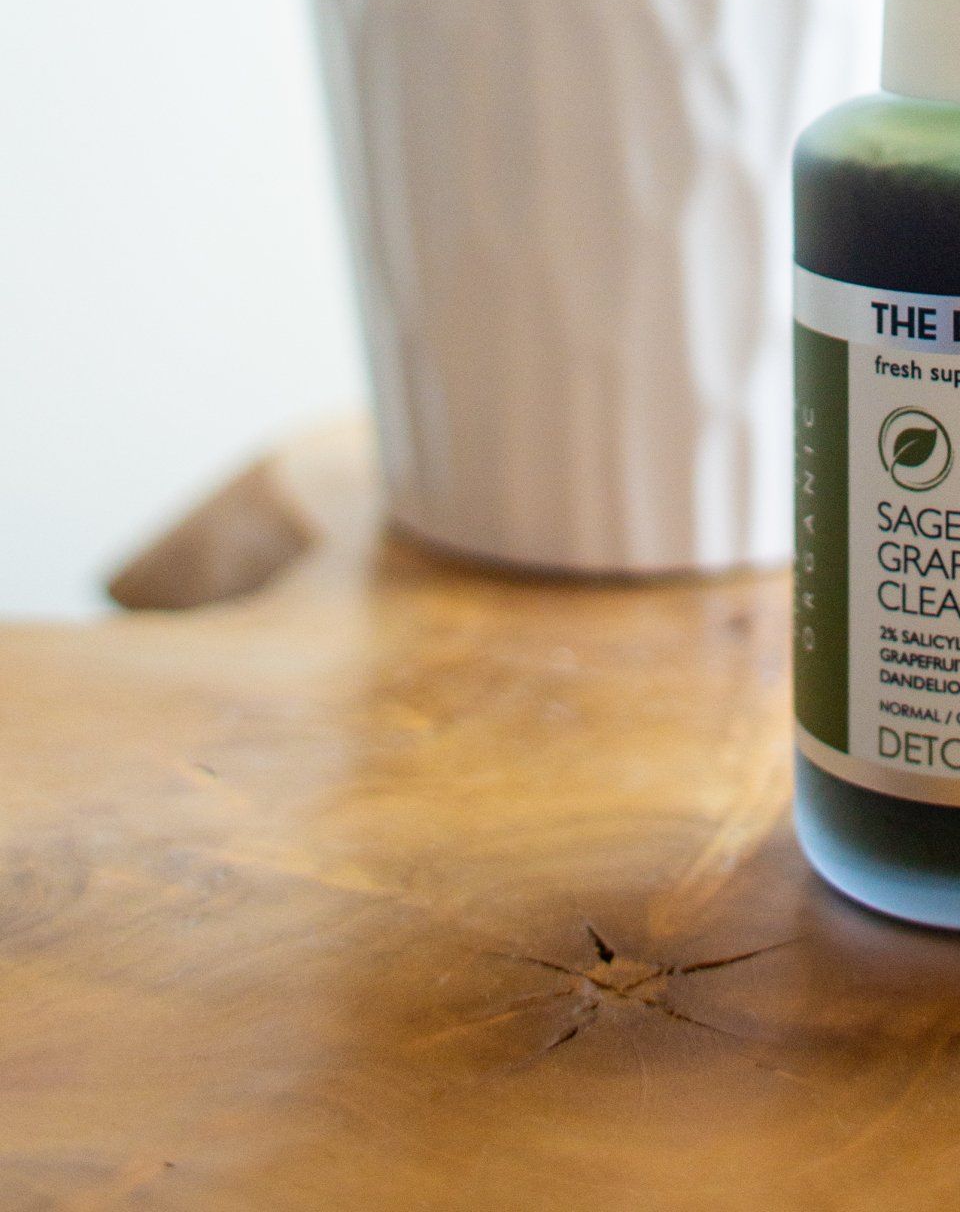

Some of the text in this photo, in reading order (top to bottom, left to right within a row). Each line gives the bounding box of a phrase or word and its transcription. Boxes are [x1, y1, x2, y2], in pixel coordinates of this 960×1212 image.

[871, 302, 937, 340] THE
[875, 356, 922, 380] fresh
[801, 404, 815, 651] ORGANIC
[880, 625, 897, 642] 2%
[880, 700, 940, 724] NORMAL
